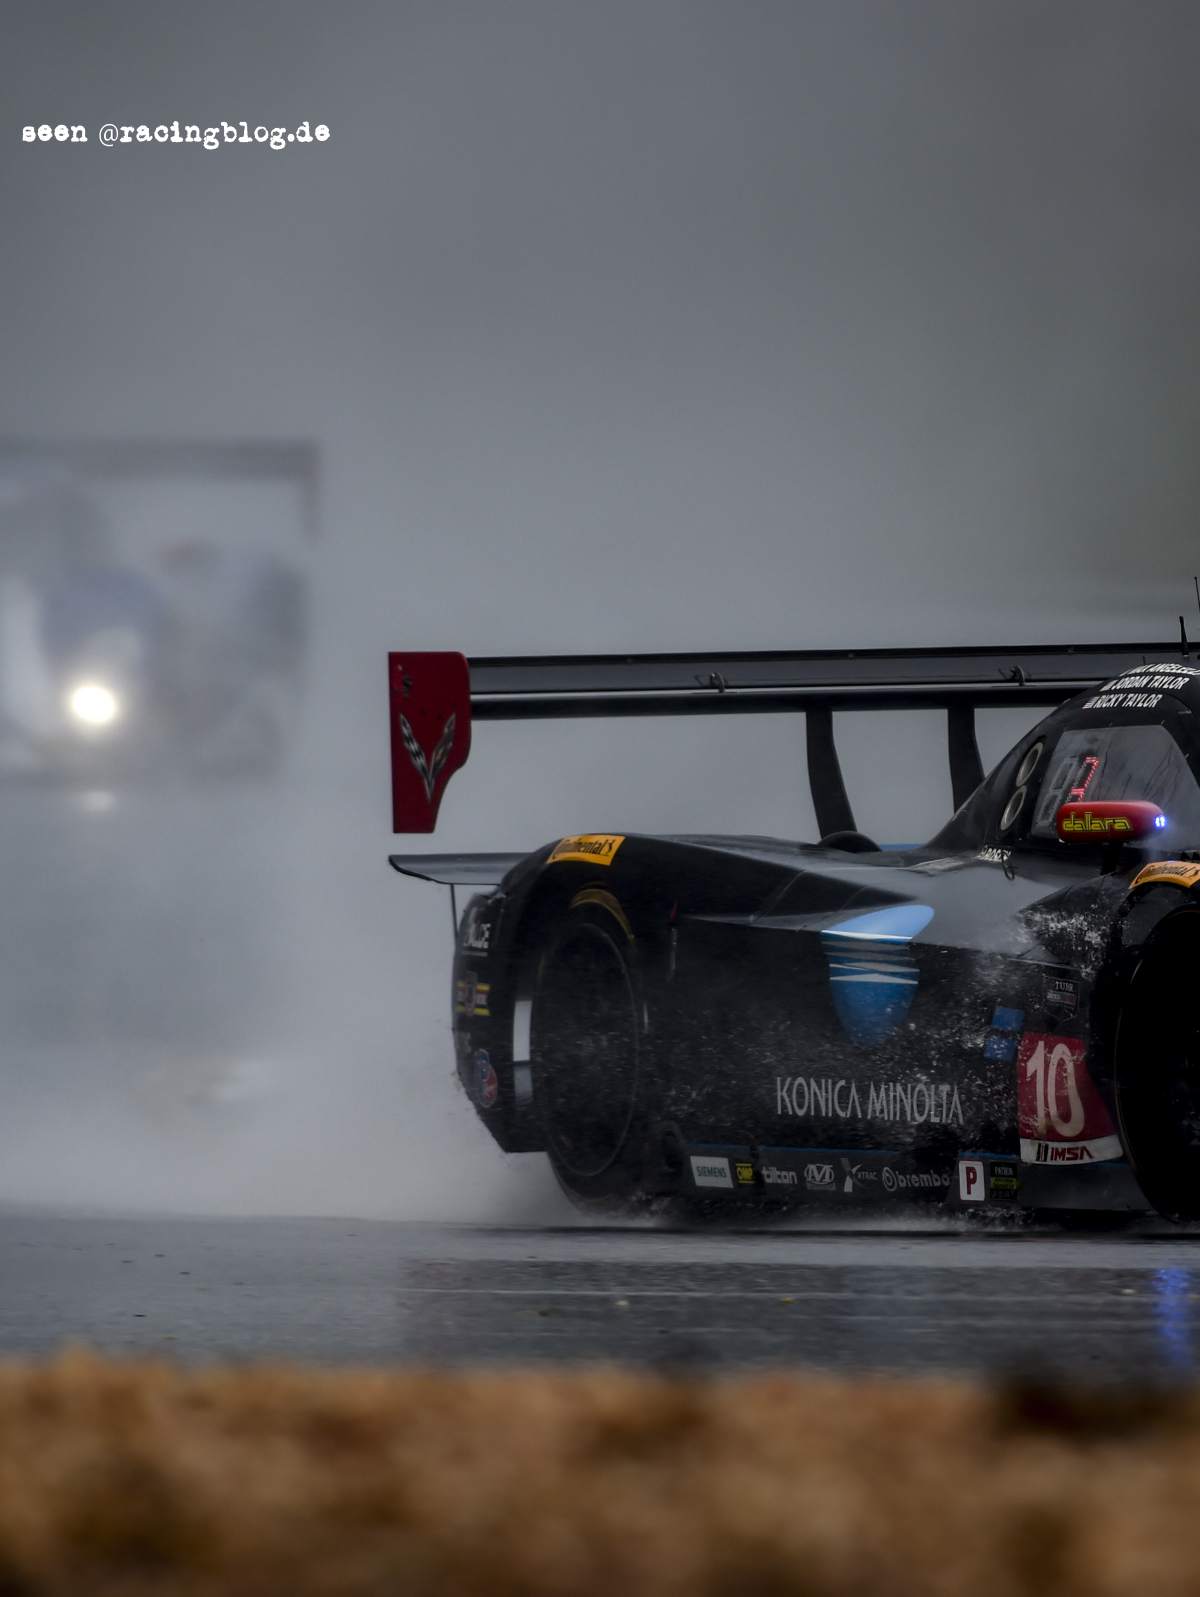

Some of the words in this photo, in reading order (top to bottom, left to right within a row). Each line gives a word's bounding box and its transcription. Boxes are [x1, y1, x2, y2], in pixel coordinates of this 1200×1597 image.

[1148, 676, 1190, 689] TAYLOR
[1093, 694, 1126, 708] RICKY
[1122, 694, 1163, 708] TAYLOR
[1062, 811, 1131, 833] dallara
[1027, 1040, 1085, 1137] 10
[776, 1076, 862, 1118] KONICA
[867, 1080, 964, 1125] MINOLTA
[1050, 1146, 1093, 1161] IMSA
[696, 1166, 727, 1178] SIEMENS
[895, 1169, 950, 1189] brembo
[965, 1166, 977, 1195] P
